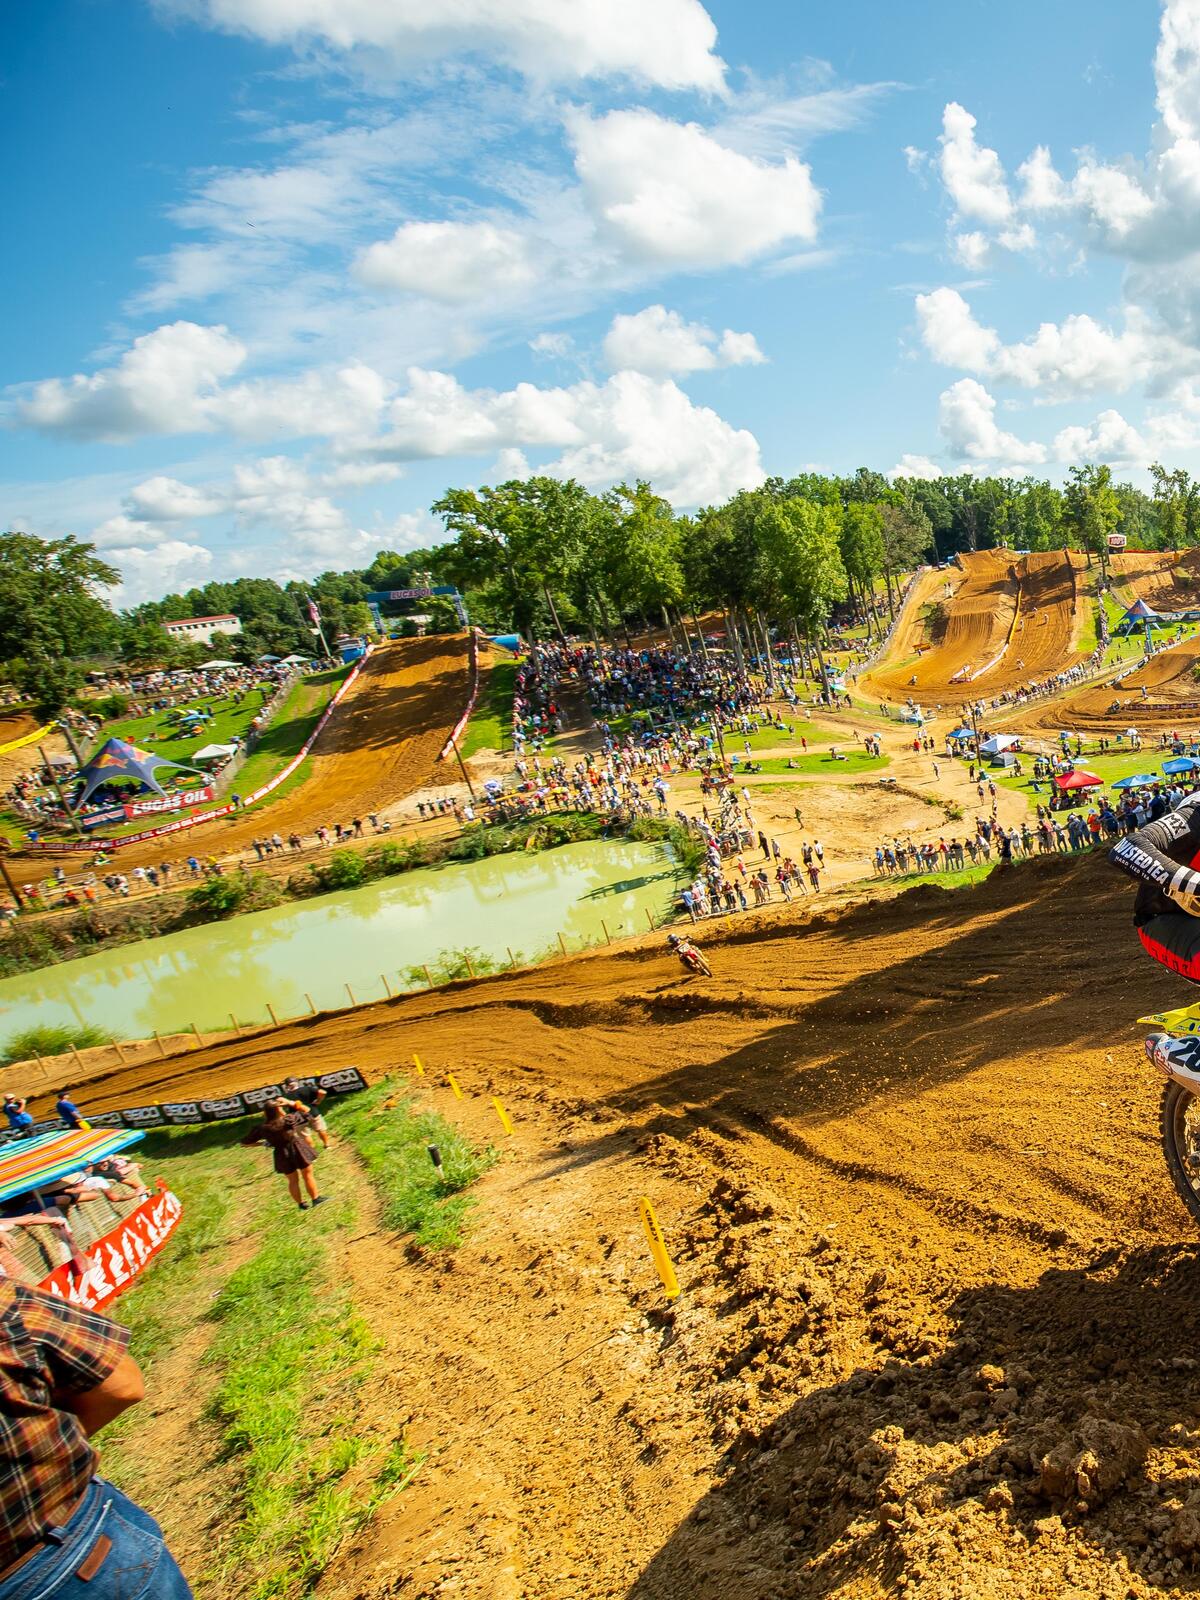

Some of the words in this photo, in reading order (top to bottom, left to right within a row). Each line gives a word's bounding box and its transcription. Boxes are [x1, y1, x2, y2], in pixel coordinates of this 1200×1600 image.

[391, 589, 419, 600] LUCAS
[421, 588, 433, 597] OIL
[133, 796, 181, 815] LUCAS
[184, 790, 209, 804] OIL
[1163, 814, 1187, 835] MX
[1113, 837, 1153, 869] WISTED
[1146, 860, 1170, 886] TEA
[320, 1070, 359, 1088] GEICO
[243, 1086, 282, 1104] GEICO
[201, 1097, 241, 1112] GEICO
